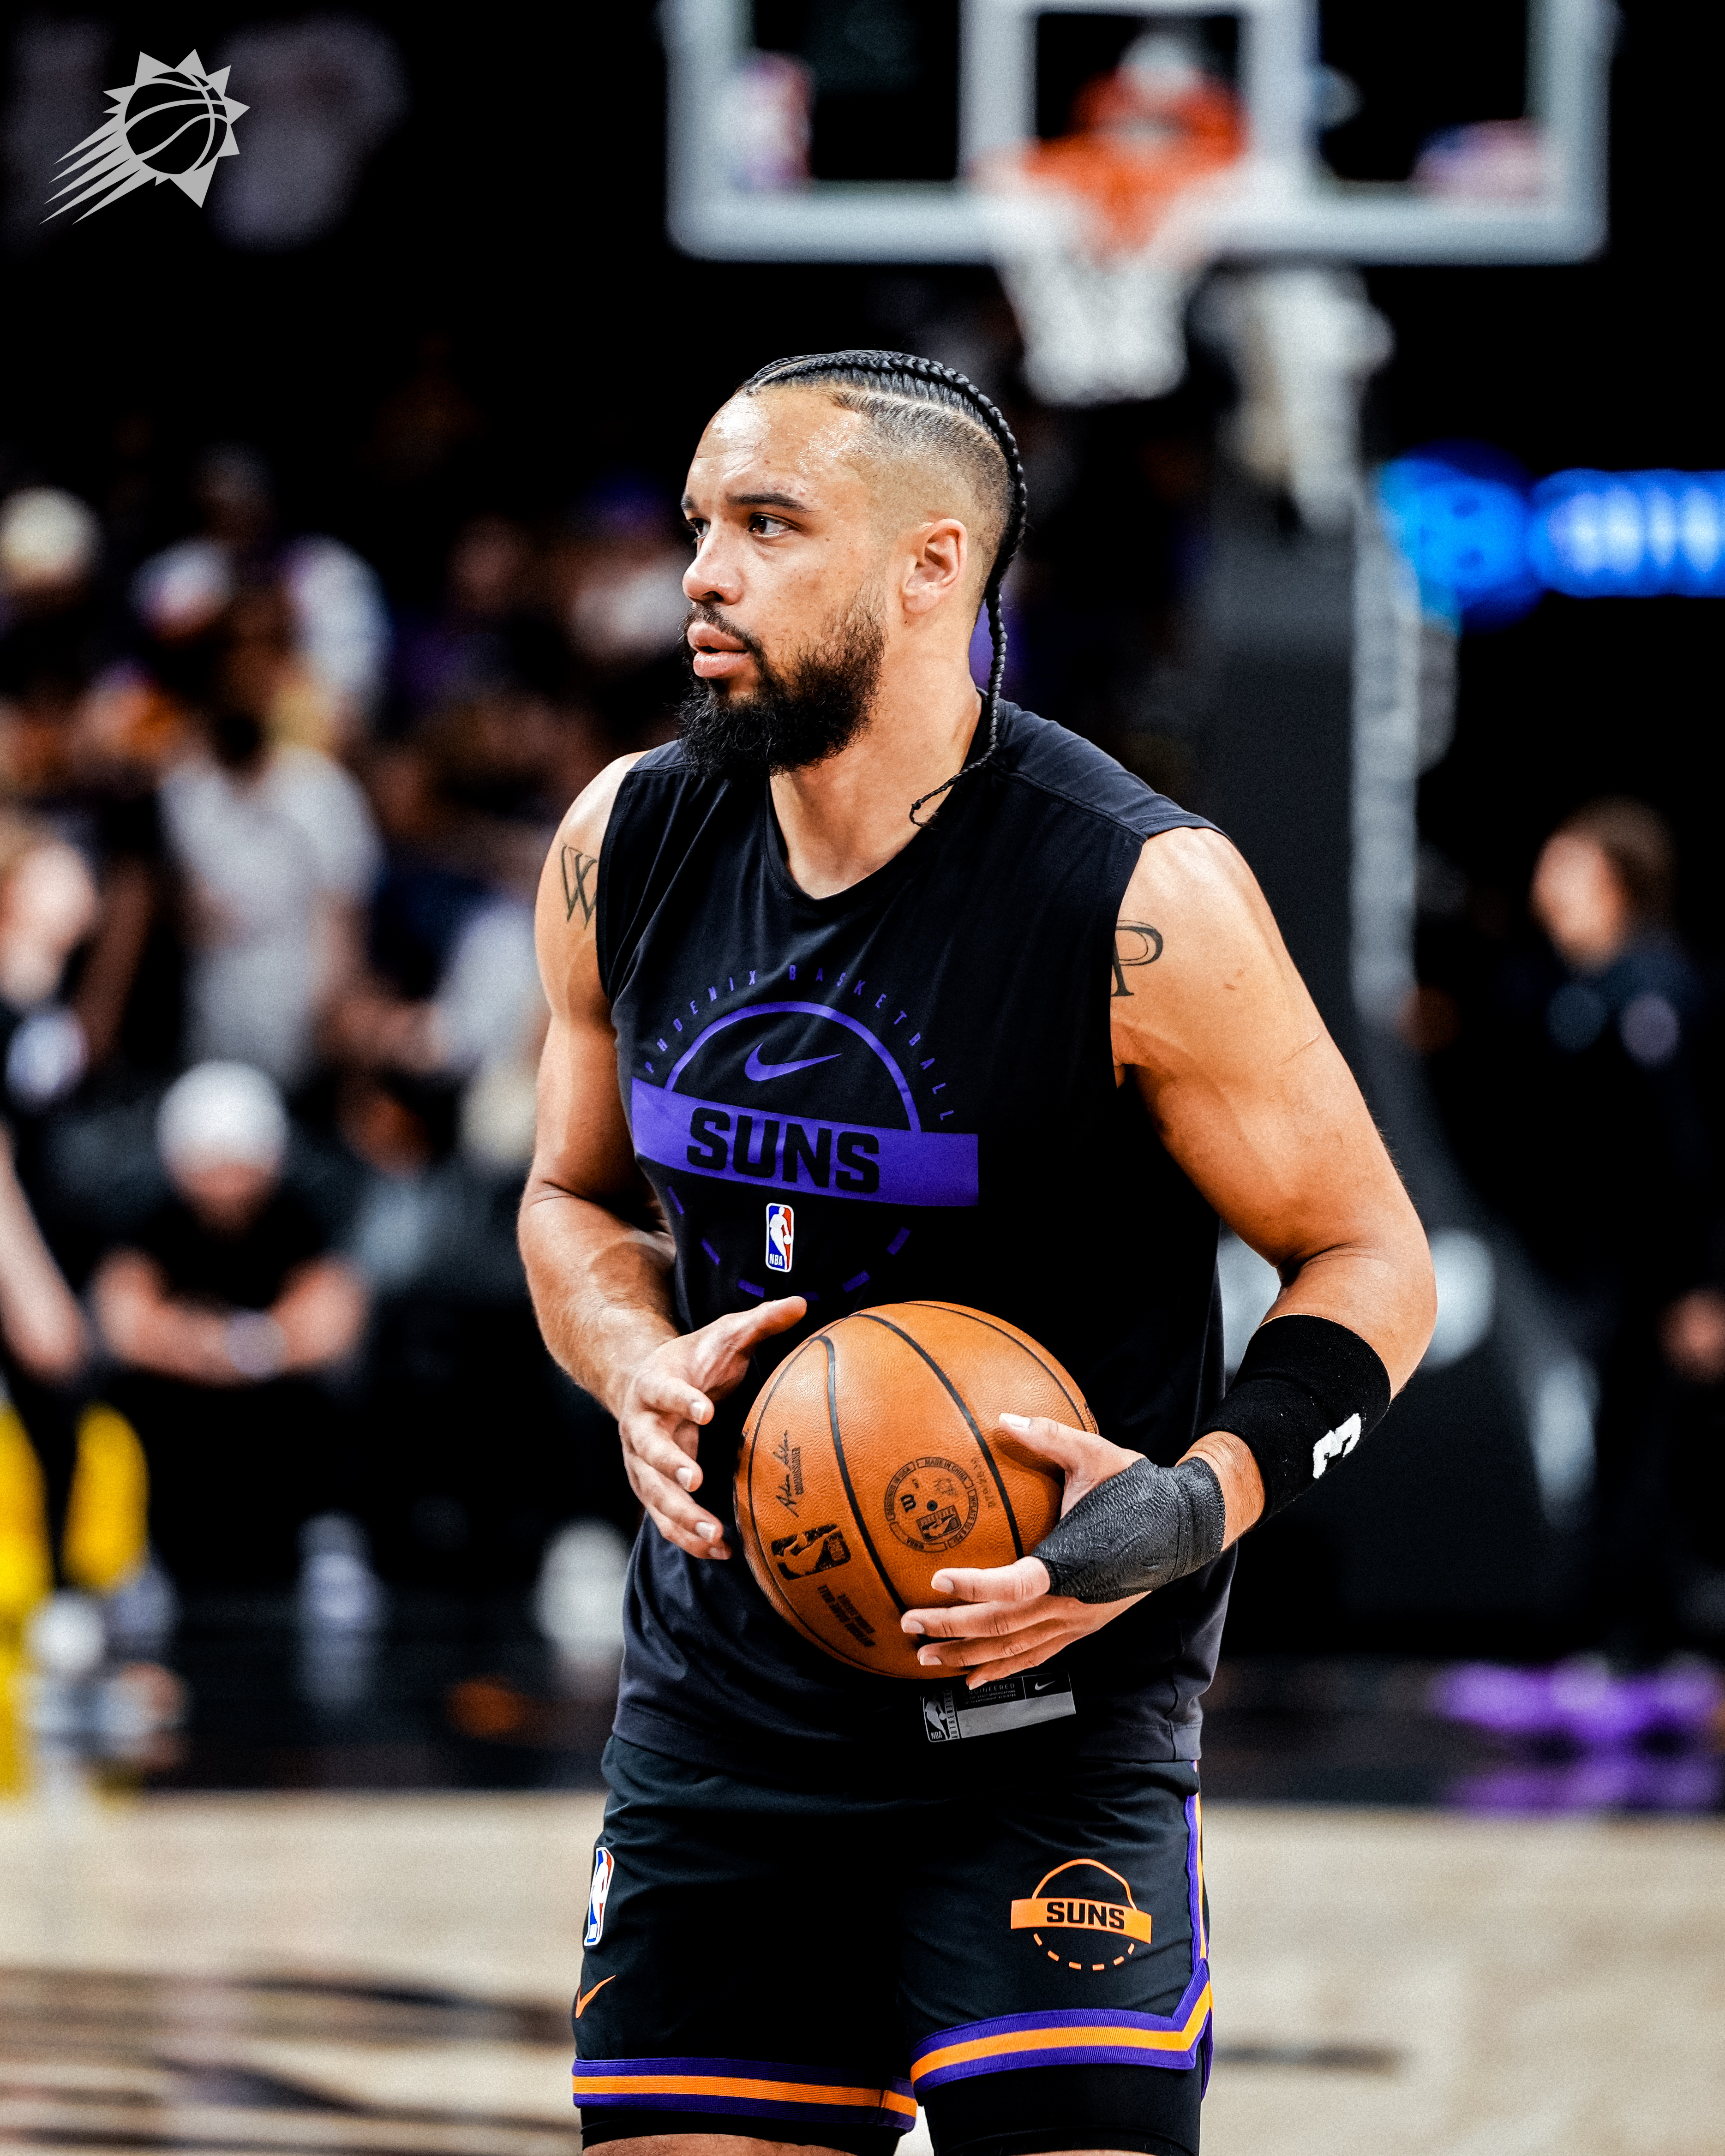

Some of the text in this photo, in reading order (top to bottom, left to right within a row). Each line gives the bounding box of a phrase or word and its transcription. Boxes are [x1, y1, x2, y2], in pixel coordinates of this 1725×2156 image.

[1111, 920, 1163, 997] P
[645, 964, 954, 1120] PHOENIX BASKETBALL
[686, 1107, 880, 1194] SUNS
[769, 1253, 783, 1266] NBA
[951, 1464, 969, 1482] CHINA
[931, 1731, 943, 1740] NBA
[1046, 1902, 1125, 1930] SUNS
